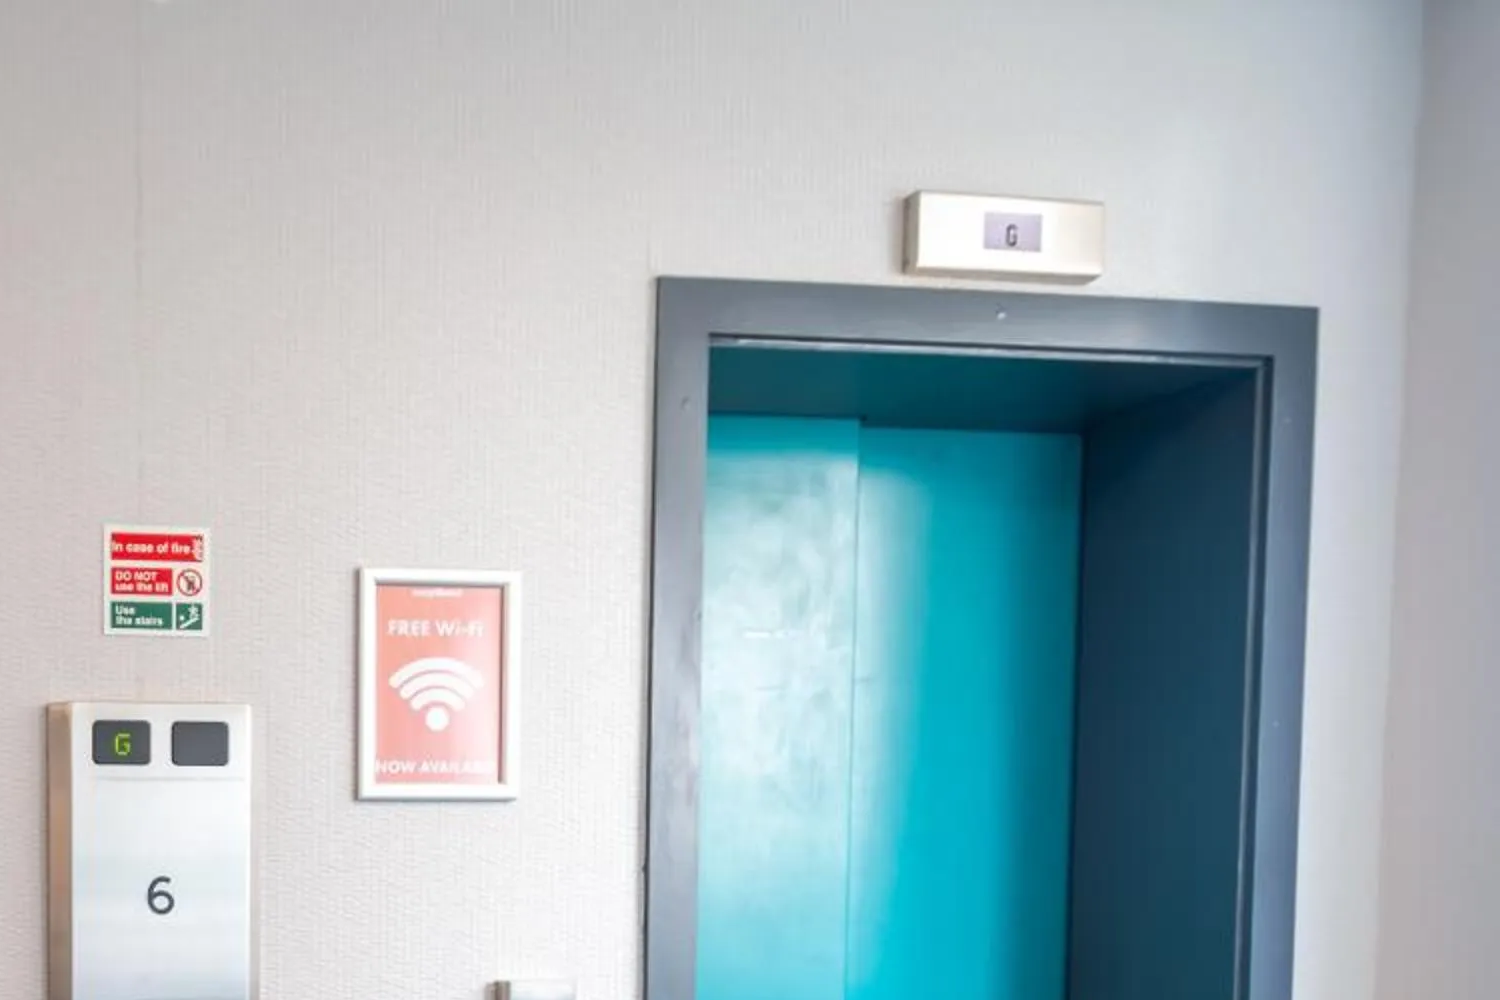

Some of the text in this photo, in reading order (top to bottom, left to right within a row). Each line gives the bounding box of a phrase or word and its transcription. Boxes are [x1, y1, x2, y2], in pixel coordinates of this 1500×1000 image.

[1005, 224, 1018, 247] G
[125, 543, 154, 553] case
[156, 541, 169, 553] of
[171, 541, 190, 554] fire
[115, 571, 158, 581] DO NOT
[115, 583, 133, 592] use
[136, 581, 153, 592] the
[115, 605, 135, 615] Use
[116, 616, 163, 626] the stairs
[387, 619, 431, 636] FREE
[114, 732, 132, 756] G
[375, 760, 416, 774] NOW
[147, 876, 175, 915] 6
